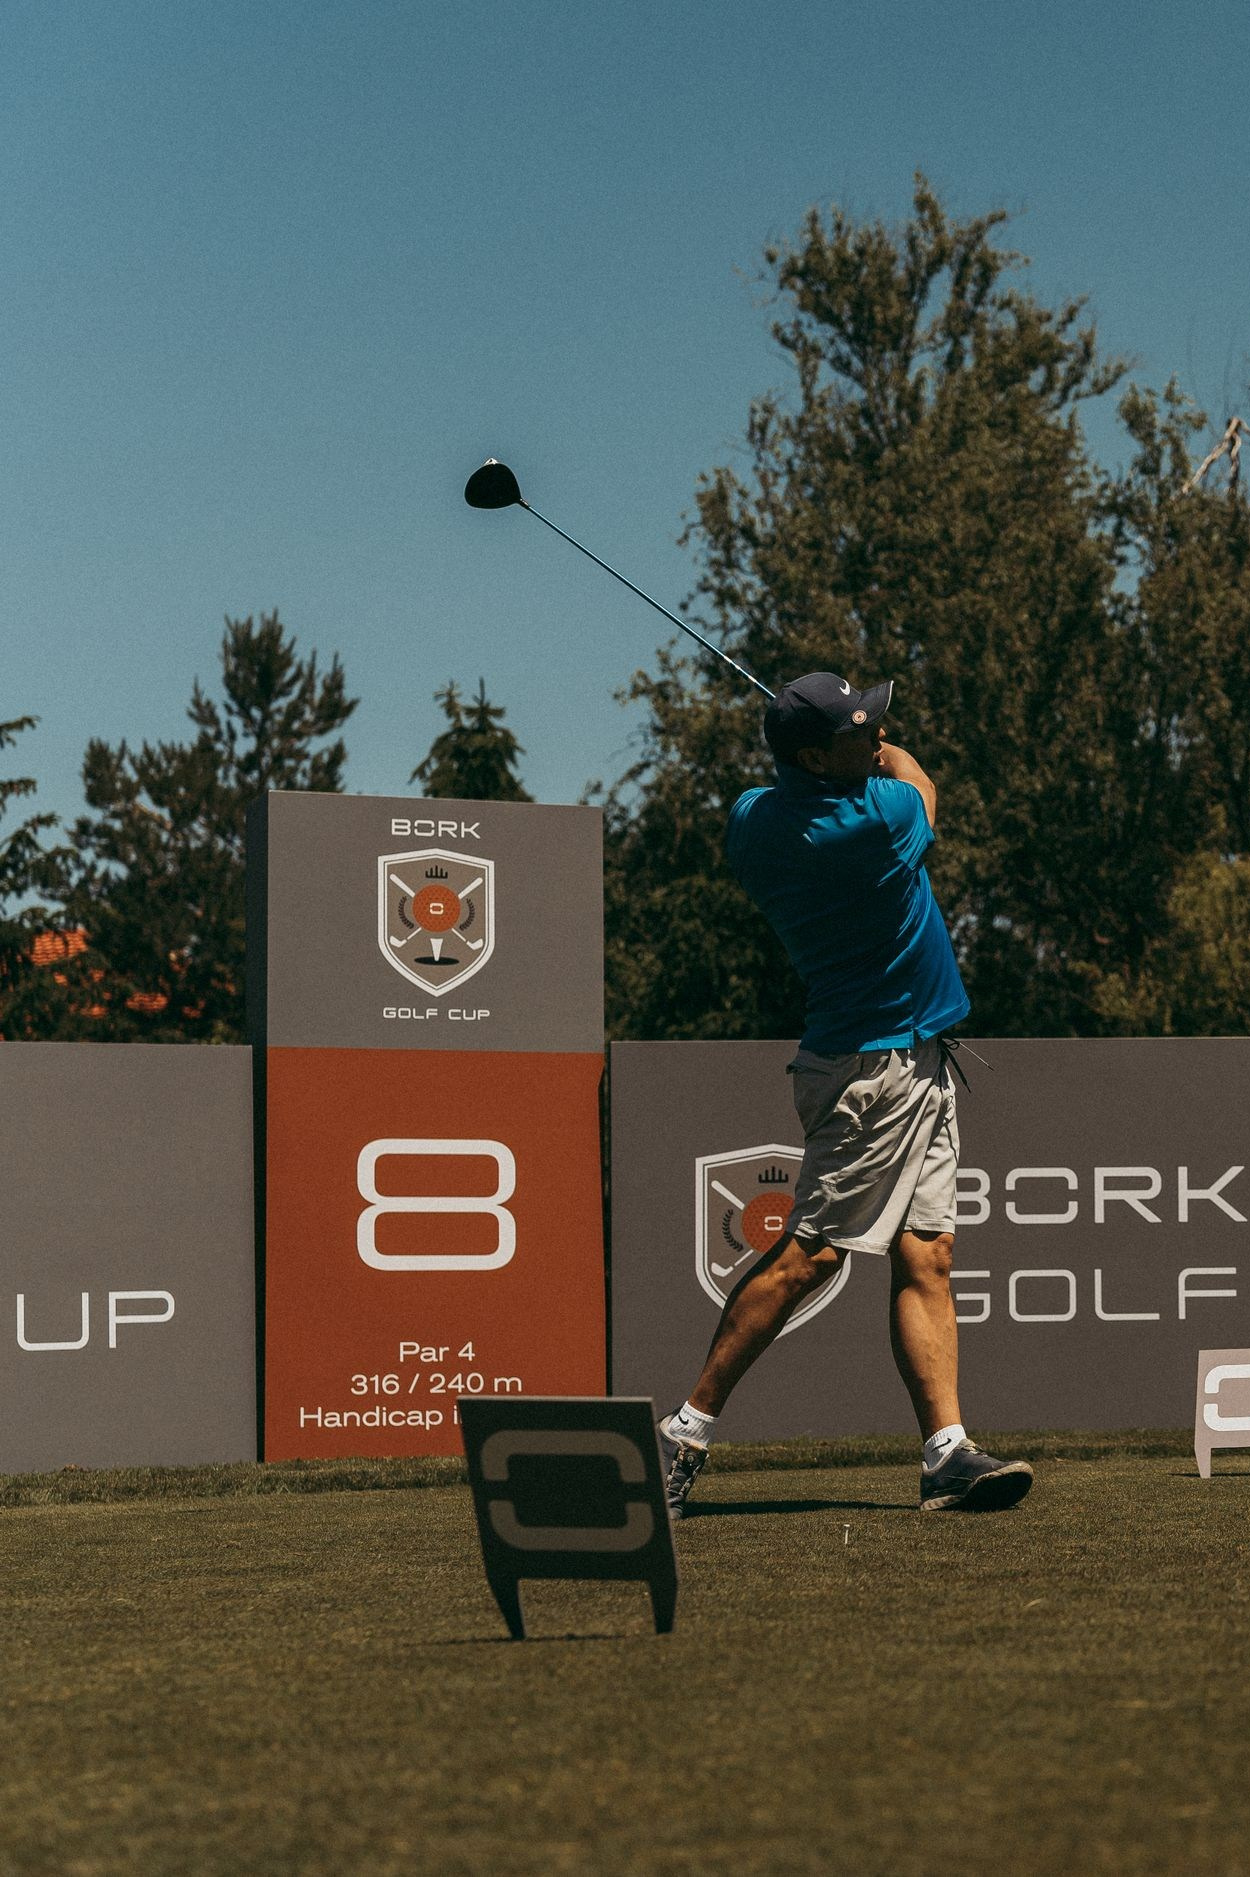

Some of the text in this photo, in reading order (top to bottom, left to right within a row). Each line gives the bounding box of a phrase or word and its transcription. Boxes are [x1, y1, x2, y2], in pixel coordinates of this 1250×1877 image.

[391, 818, 481, 839] BORK
[382, 1007, 491, 1021] GOLF CUP
[356, 1138, 517, 1272] 8
[955, 1165, 1248, 1225] BORK
[949, 1266, 1237, 1323] GOLF
[399, 1341, 476, 1363] Par 4
[350, 1372, 523, 1395] 316 / 240 m
[299, 1405, 444, 1431] Handicap
